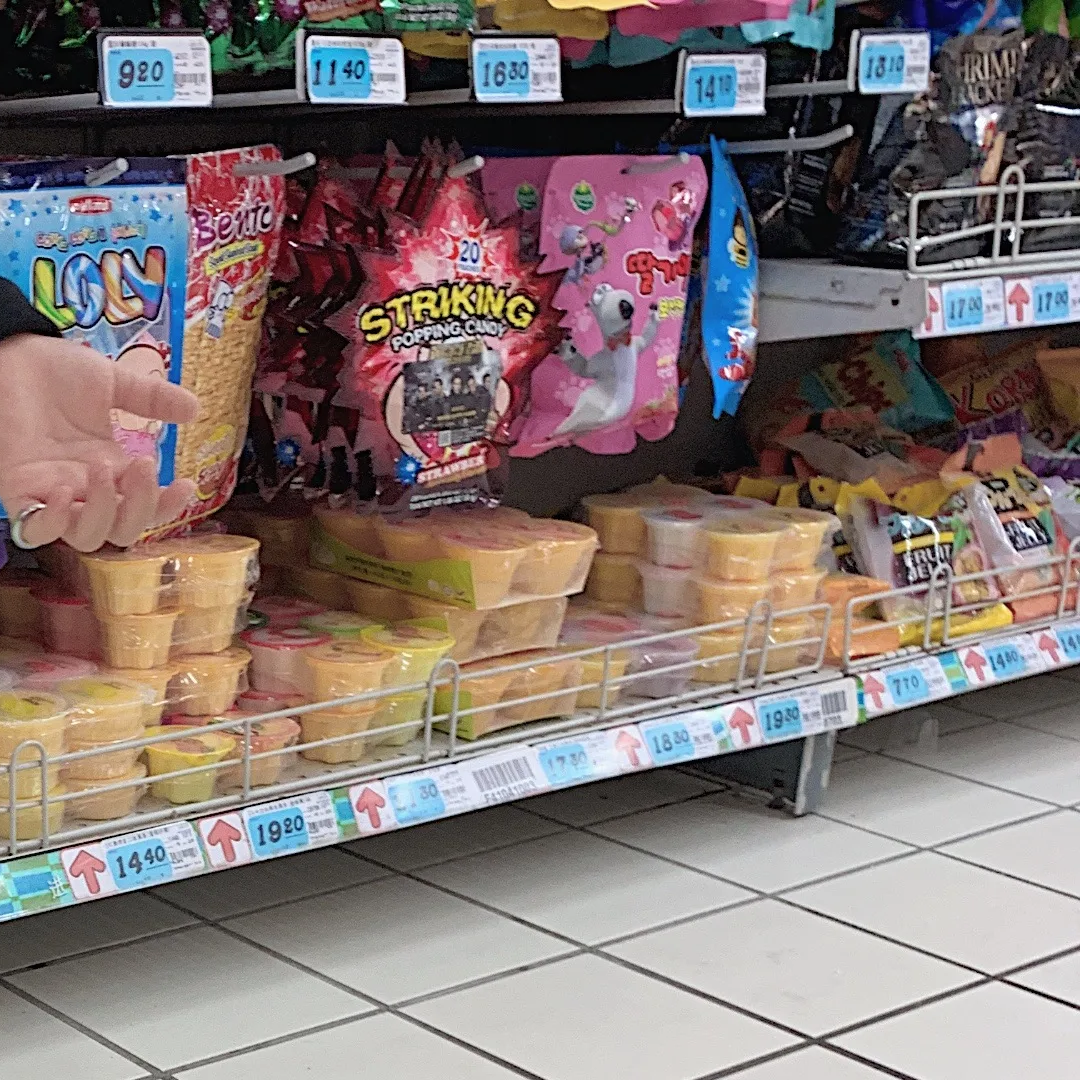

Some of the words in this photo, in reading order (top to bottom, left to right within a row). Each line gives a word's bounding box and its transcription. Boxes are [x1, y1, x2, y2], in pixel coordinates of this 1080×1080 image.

[460, 239, 482, 264] 20
[358, 282, 538, 343] STRIKING
[391, 320, 461, 353] POPPING
[464, 318, 508, 338] CANDY
[906, 561, 949, 584] JEL
